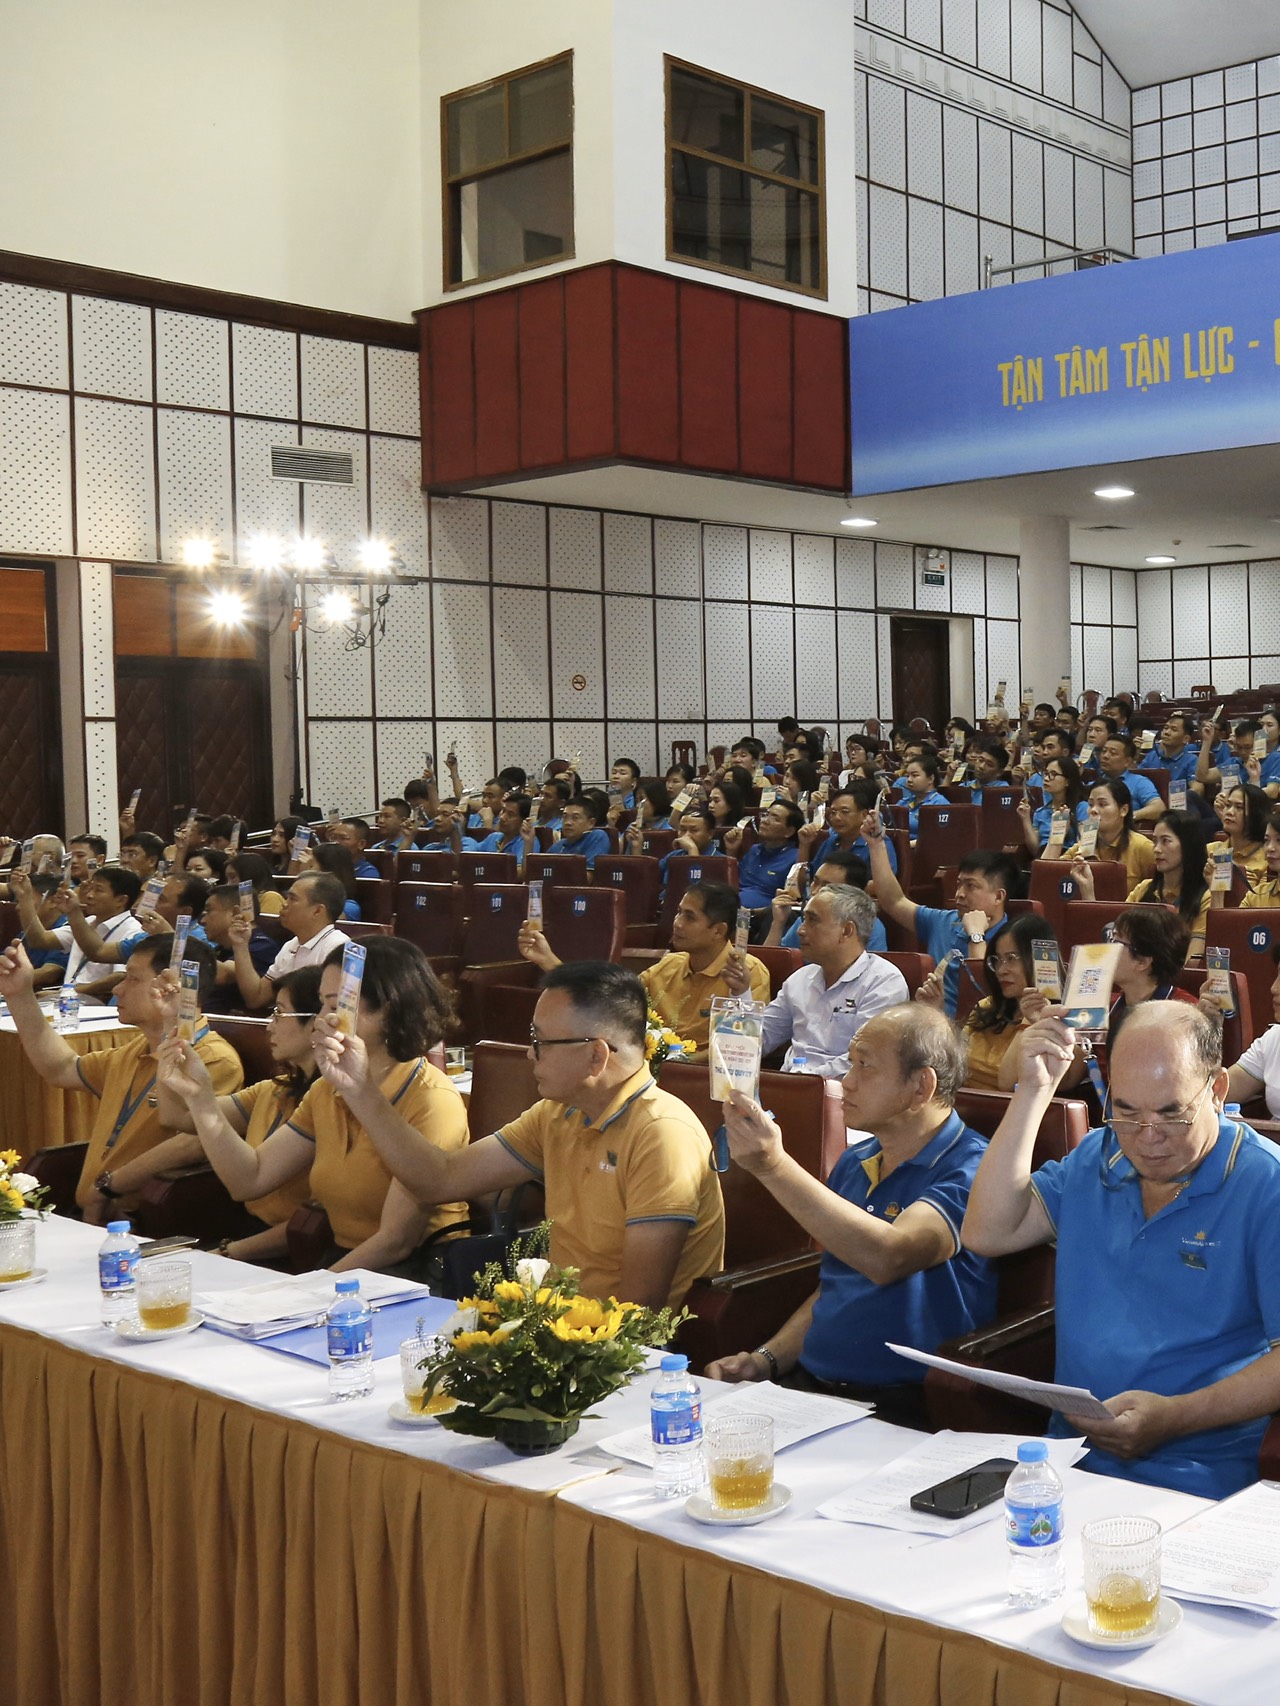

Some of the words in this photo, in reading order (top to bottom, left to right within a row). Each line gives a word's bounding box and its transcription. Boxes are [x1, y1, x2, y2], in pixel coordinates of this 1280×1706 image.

[997, 354, 1044, 411] TẬN
[1055, 345, 1109, 398] TÂM
[1121, 333, 1171, 392] TẬN
[1184, 326, 1235, 383] LỰC
[1001, 797, 1012, 805] 137
[938, 814, 949, 822] 127
[412, 864, 421, 872] 113
[474, 866, 484, 876] 112
[543, 868, 552, 876] 111
[1062, 882, 1072, 894] 18
[416, 896, 426, 906] 102
[492, 898, 502, 908] 101
[574, 900, 586, 911] 100
[1252, 932, 1266, 946] 06
